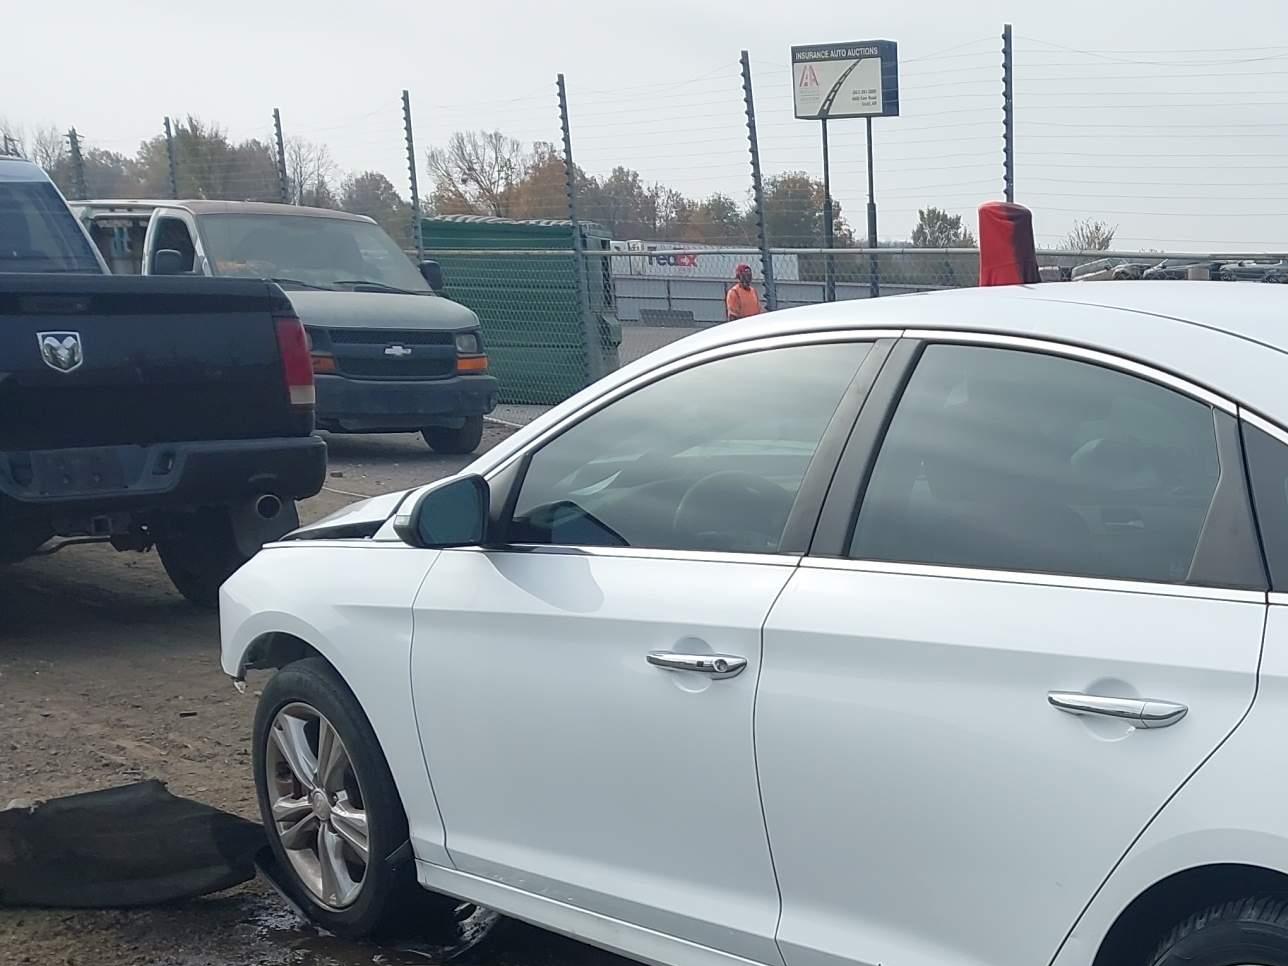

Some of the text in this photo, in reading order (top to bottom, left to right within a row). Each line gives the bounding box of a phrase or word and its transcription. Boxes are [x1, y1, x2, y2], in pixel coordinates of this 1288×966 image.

[795, 46, 879, 60] INSURANCE AUTO AUCTIONS
